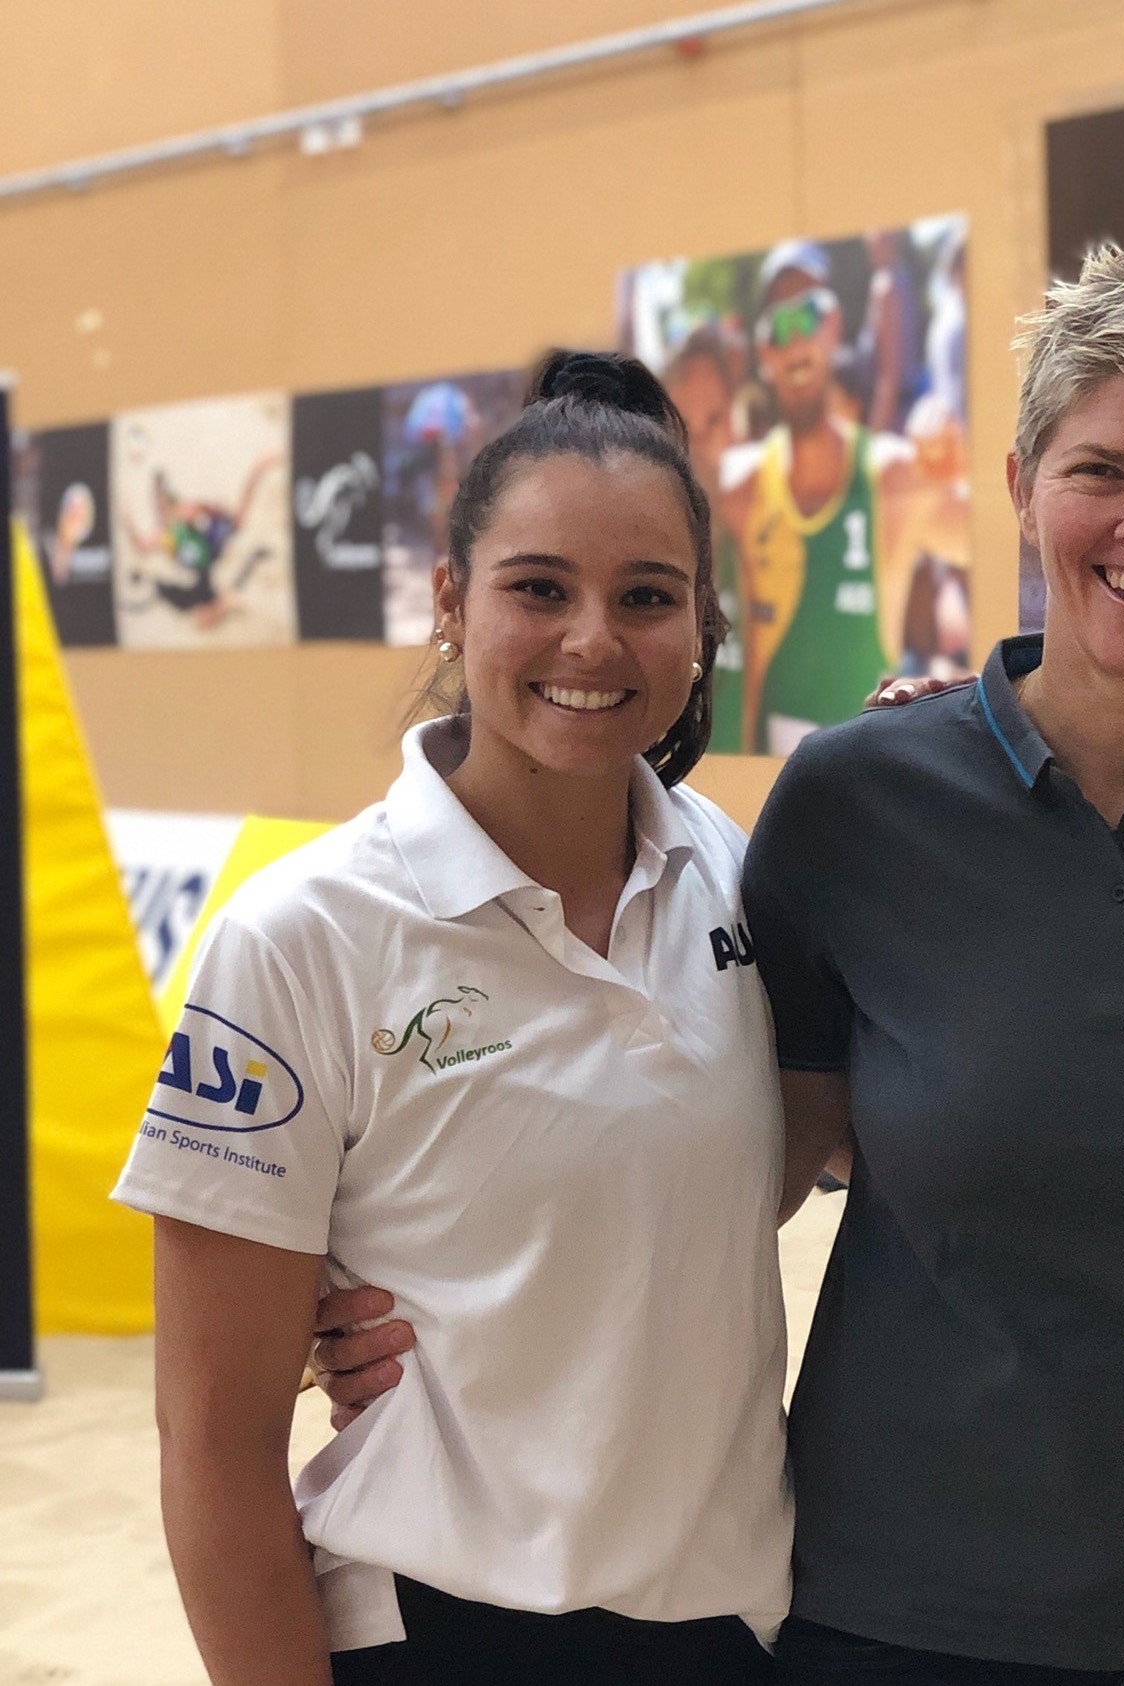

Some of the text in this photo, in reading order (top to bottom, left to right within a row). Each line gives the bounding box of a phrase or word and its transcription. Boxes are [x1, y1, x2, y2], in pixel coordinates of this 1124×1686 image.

[436, 1039, 513, 1070] Volleyroos
[169, 1130, 221, 1158] Sports
[223, 1147, 287, 1179] Institute
